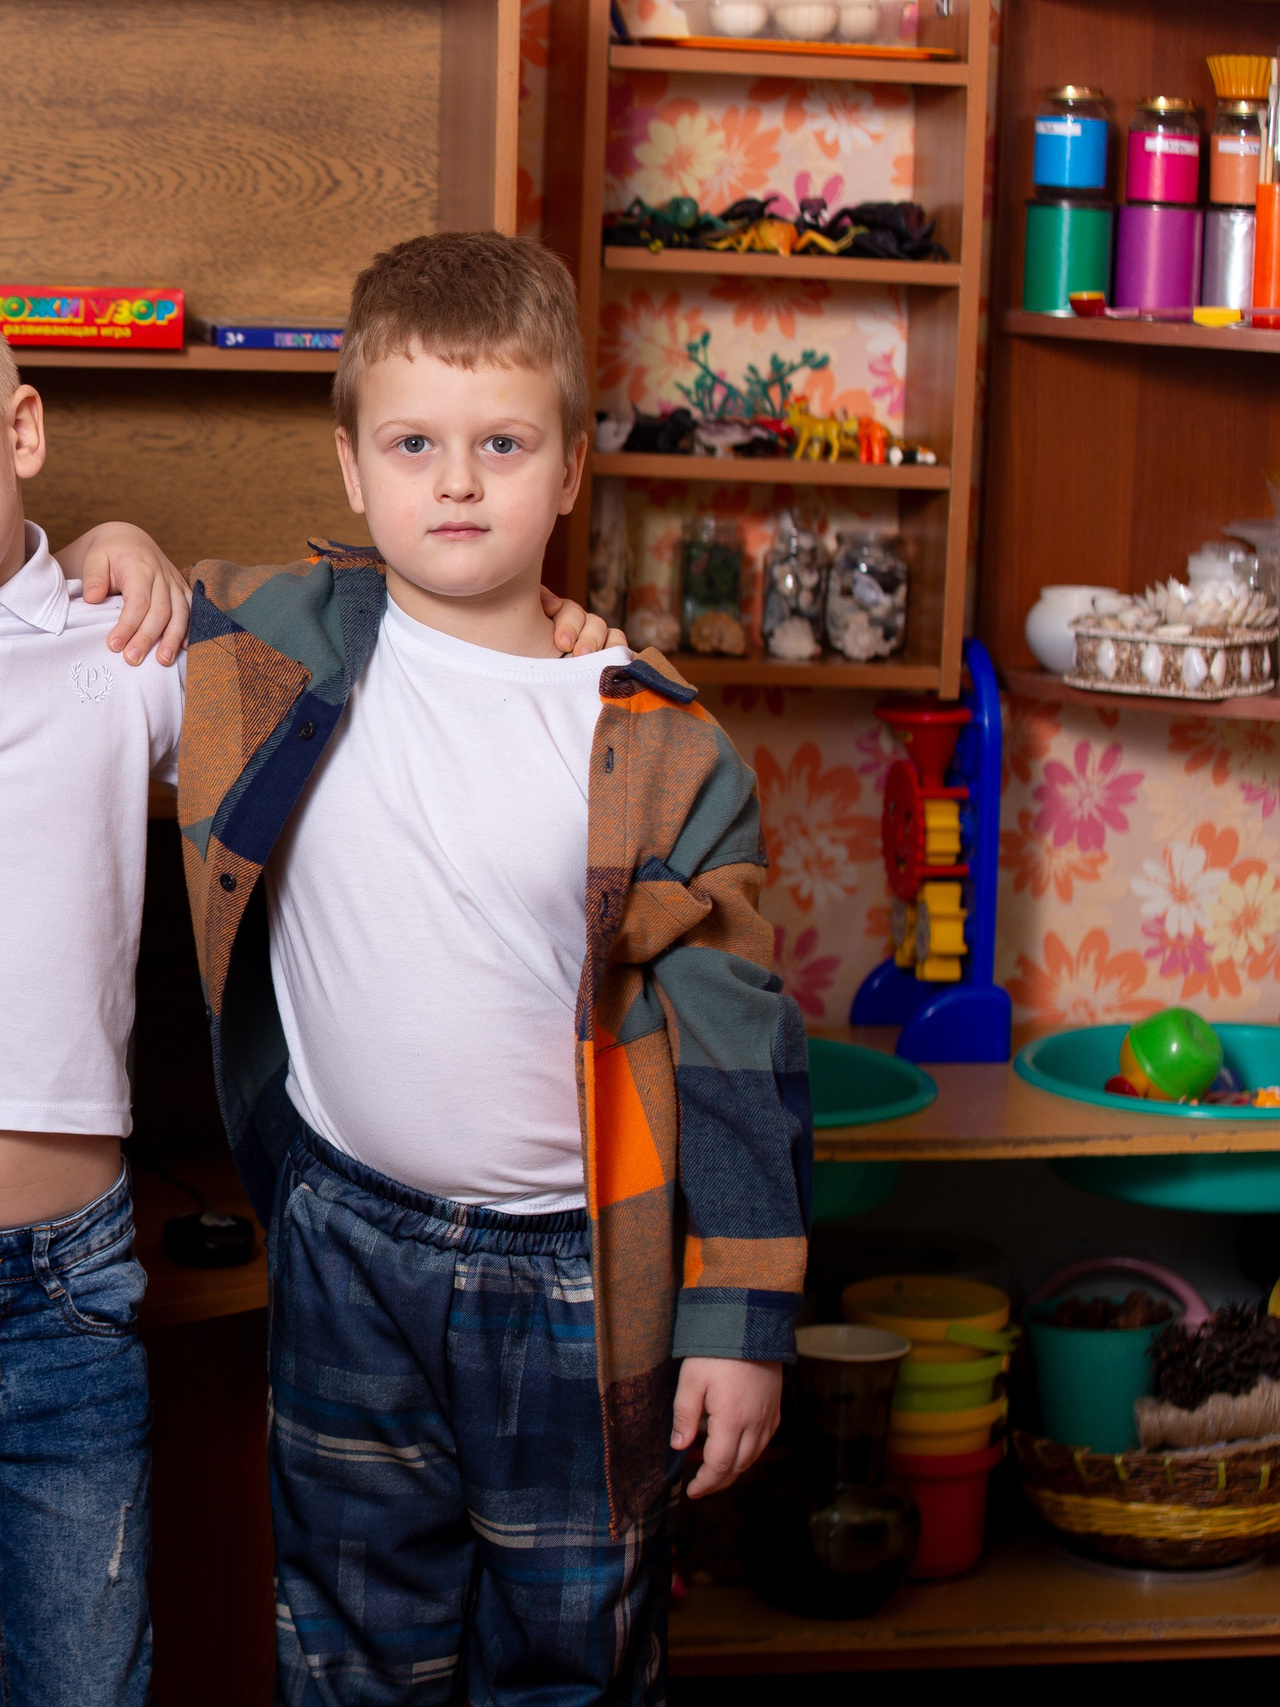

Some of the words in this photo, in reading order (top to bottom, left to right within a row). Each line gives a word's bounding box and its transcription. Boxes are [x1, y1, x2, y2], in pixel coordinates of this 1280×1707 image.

[89, 298, 178, 326] УЗОР
[225, 331, 246, 346] 3+
[84, 667, 99, 691] P
